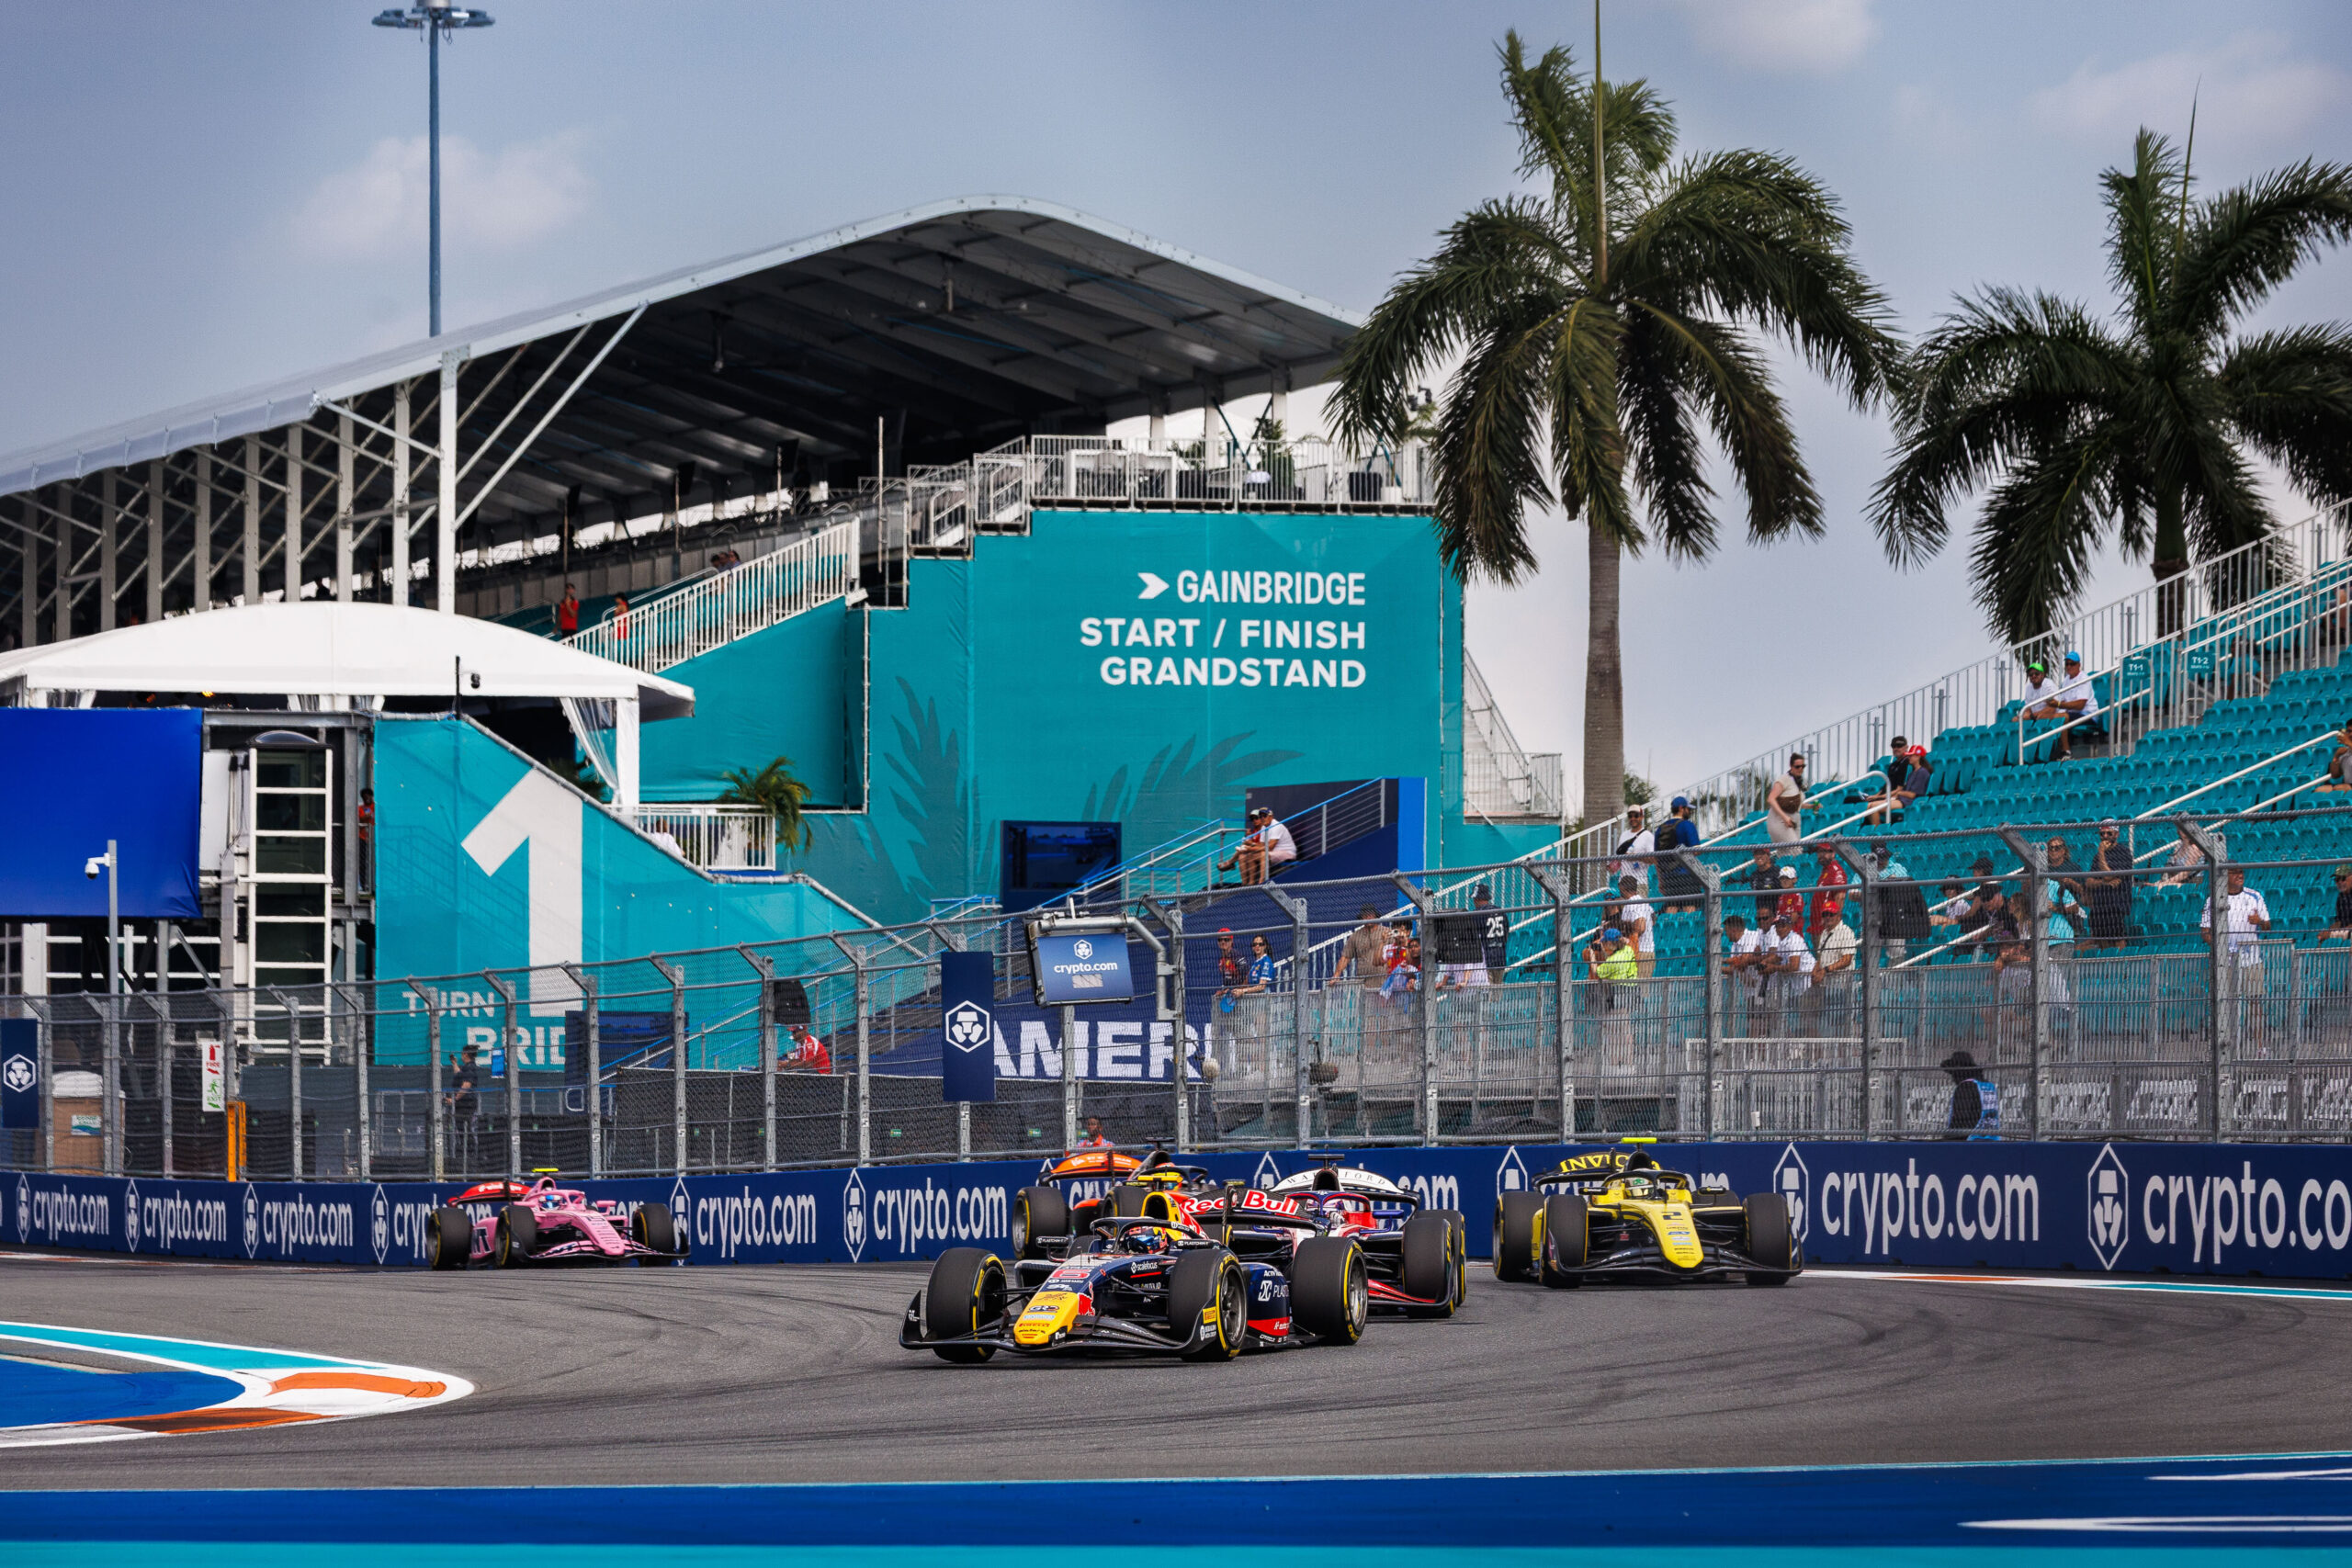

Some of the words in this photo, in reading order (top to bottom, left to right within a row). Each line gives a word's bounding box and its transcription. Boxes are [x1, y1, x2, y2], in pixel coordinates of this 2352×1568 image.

[1177, 570, 1365, 605] GAINBRIDGE
[1080, 618, 1200, 648] START
[1213, 619, 1227, 648] /
[1240, 620, 1365, 649] FINISH
[1100, 657, 1366, 688] GRANDSTAND
[460, 767, 582, 1017] 1
[1486, 916, 1504, 938] 25
[1053, 962, 1118, 974] crypto.com
[34, 1184, 108, 1240] crypto.com
[144, 1190, 227, 1249] crypto.com
[874, 1178, 1007, 1258] crypto.com
[1241, 1190, 1299, 1215] Bull
[1660, 1212, 1683, 1221] 2
[1822, 1158, 2039, 1255] crypto.com
[264, 1193, 353, 1255] crypto.com
[697, 1186, 816, 1258] crypto.com
[1050, 1269, 1092, 1279] 6
